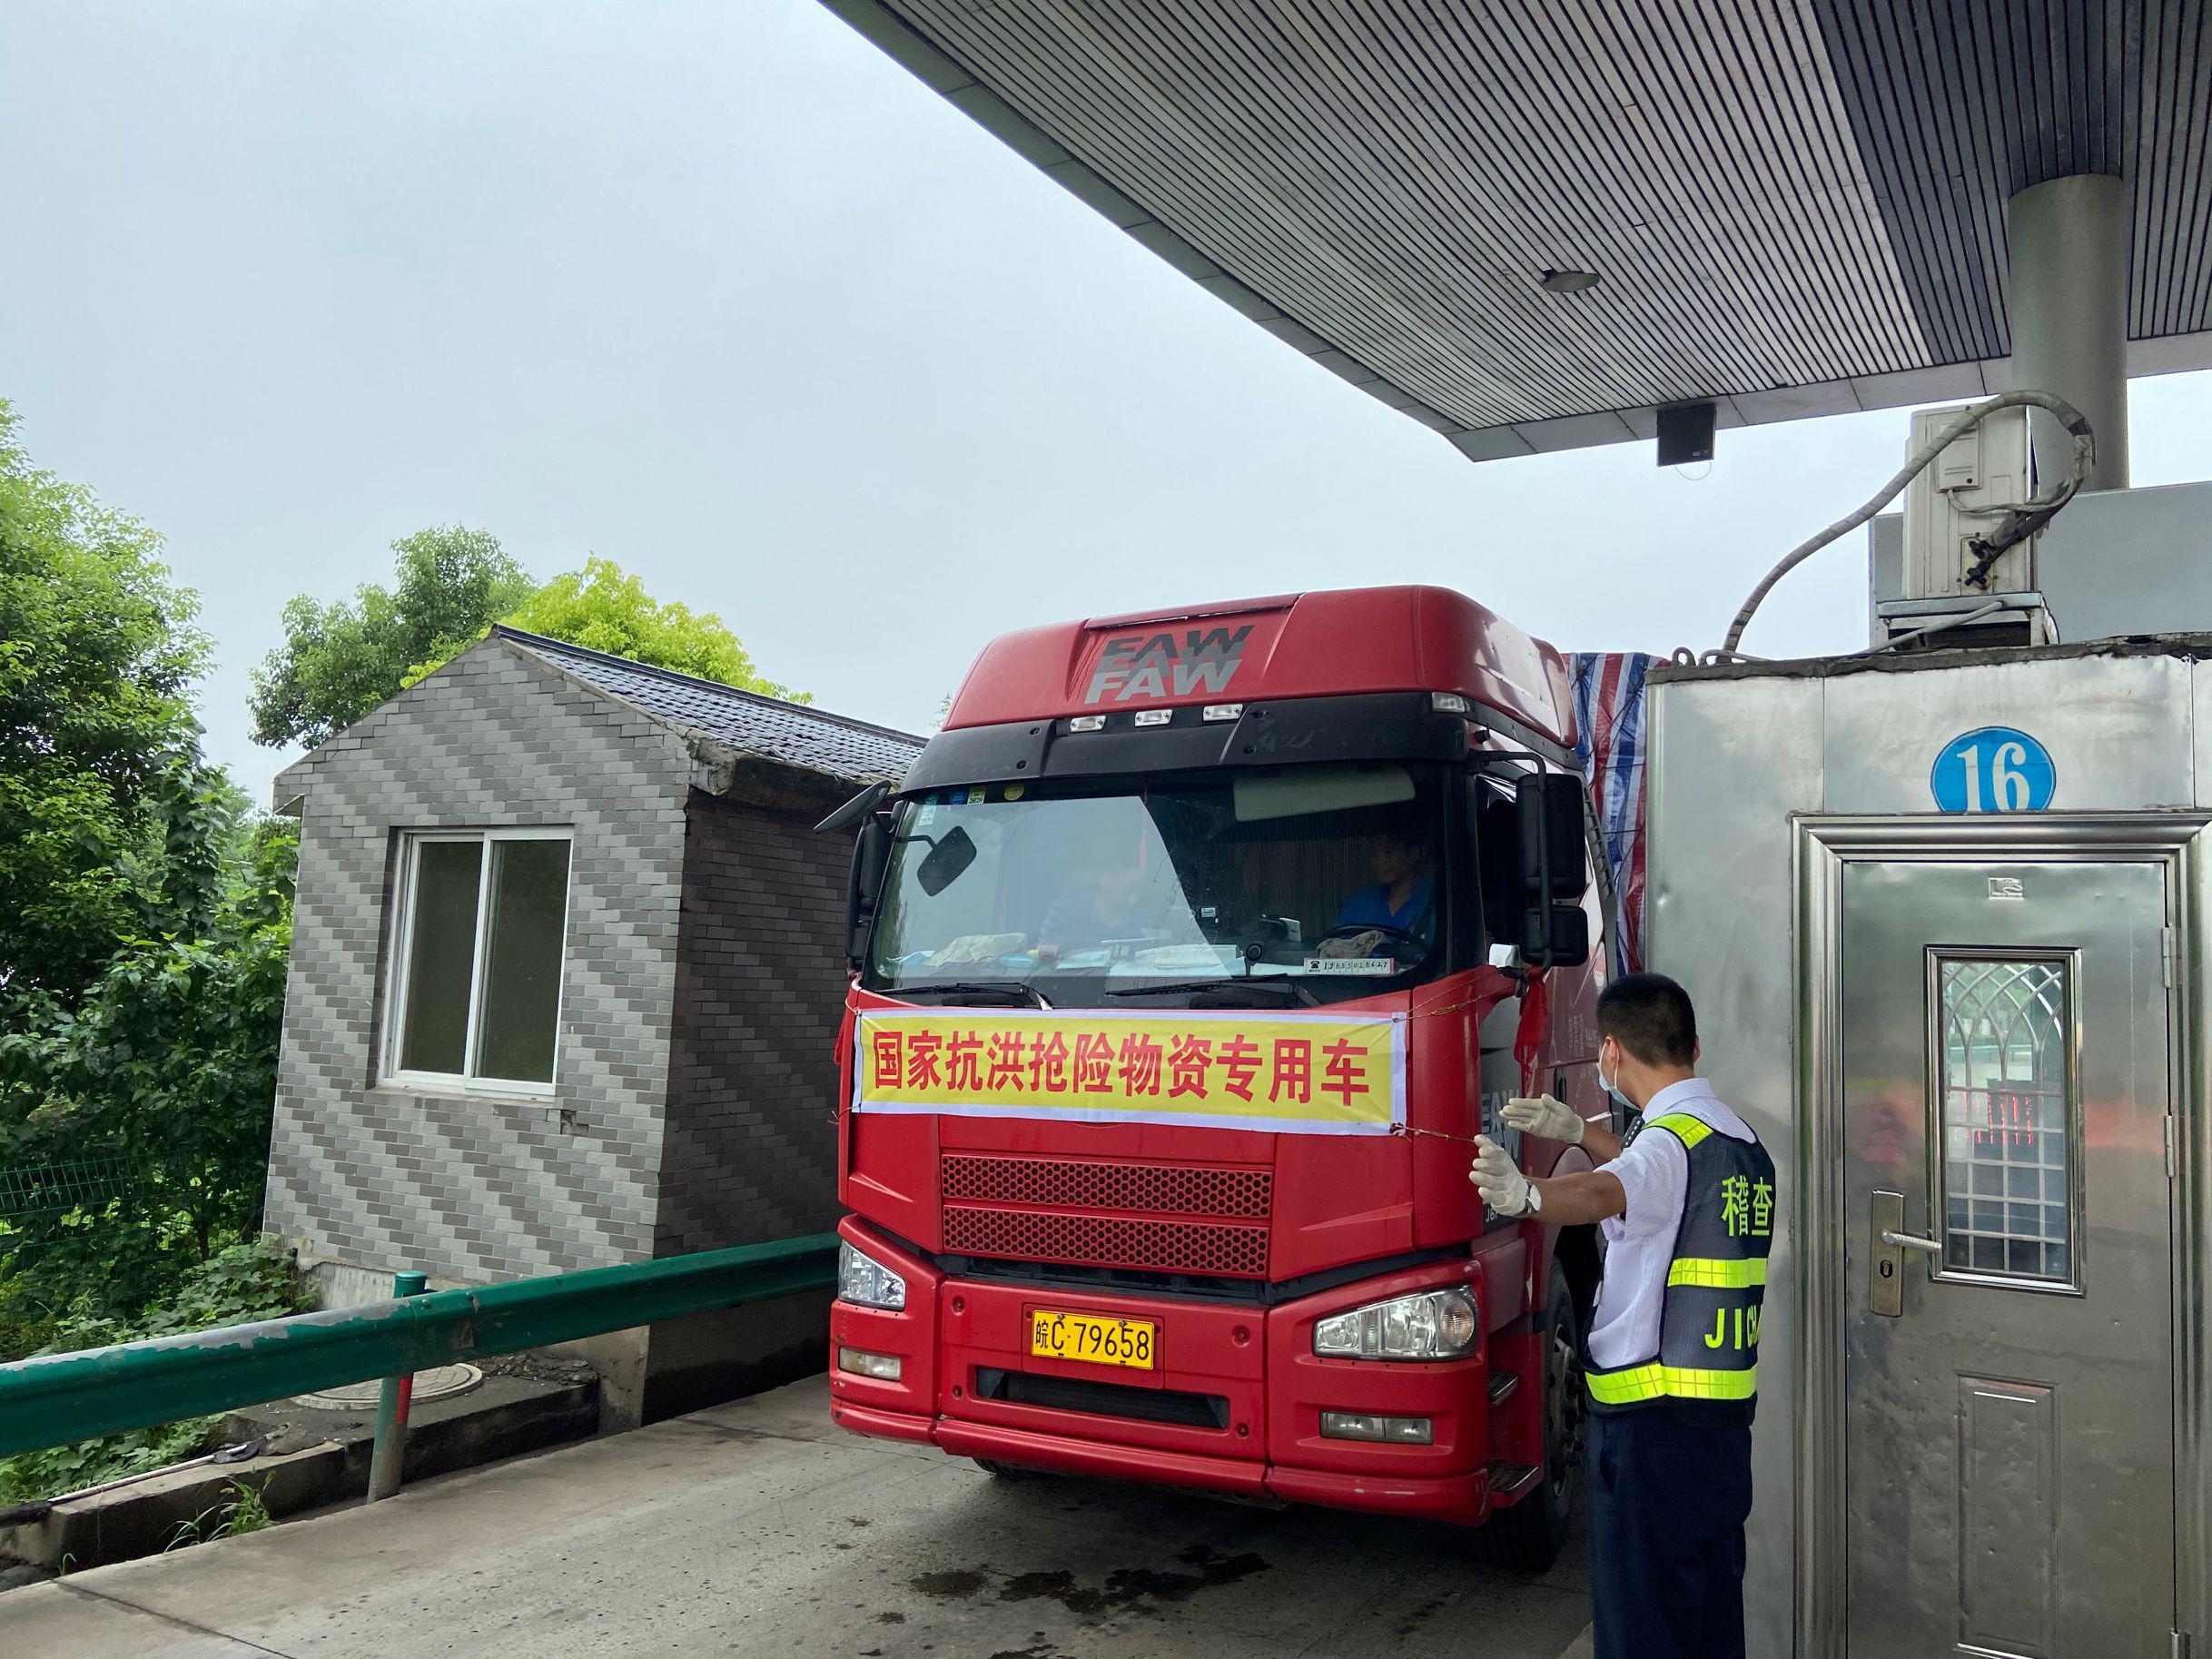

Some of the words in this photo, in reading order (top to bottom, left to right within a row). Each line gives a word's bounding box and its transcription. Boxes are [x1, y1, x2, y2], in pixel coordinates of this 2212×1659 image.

[1084, 659, 1242, 705] FAW
[1957, 742, 2030, 813] 16
[873, 1030, 1370, 1108] 国家抗洪抢险物资专用车
[1721, 1175, 1773, 1237] 稽查
